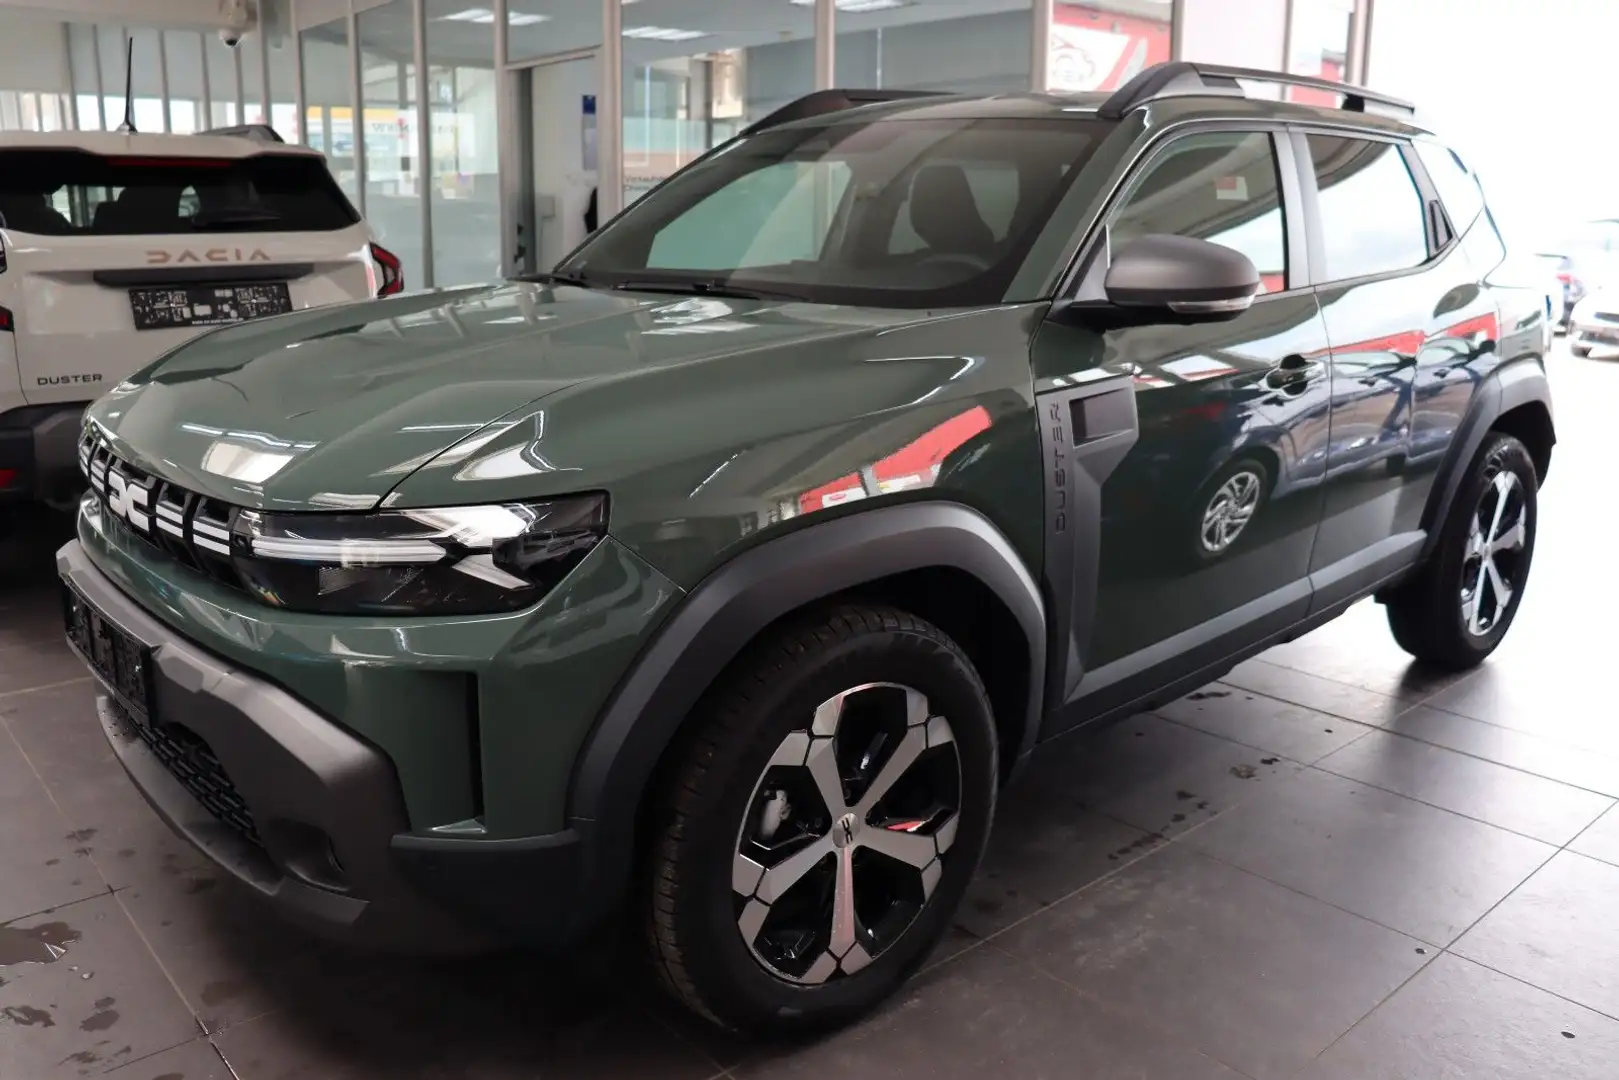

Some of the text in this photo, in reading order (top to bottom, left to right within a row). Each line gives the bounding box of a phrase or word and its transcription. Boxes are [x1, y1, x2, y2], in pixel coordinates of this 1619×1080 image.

[145, 248, 271, 264] DACIA
[37, 373, 103, 386] DUSTER
[1050, 400, 1066, 534] DUSTER
